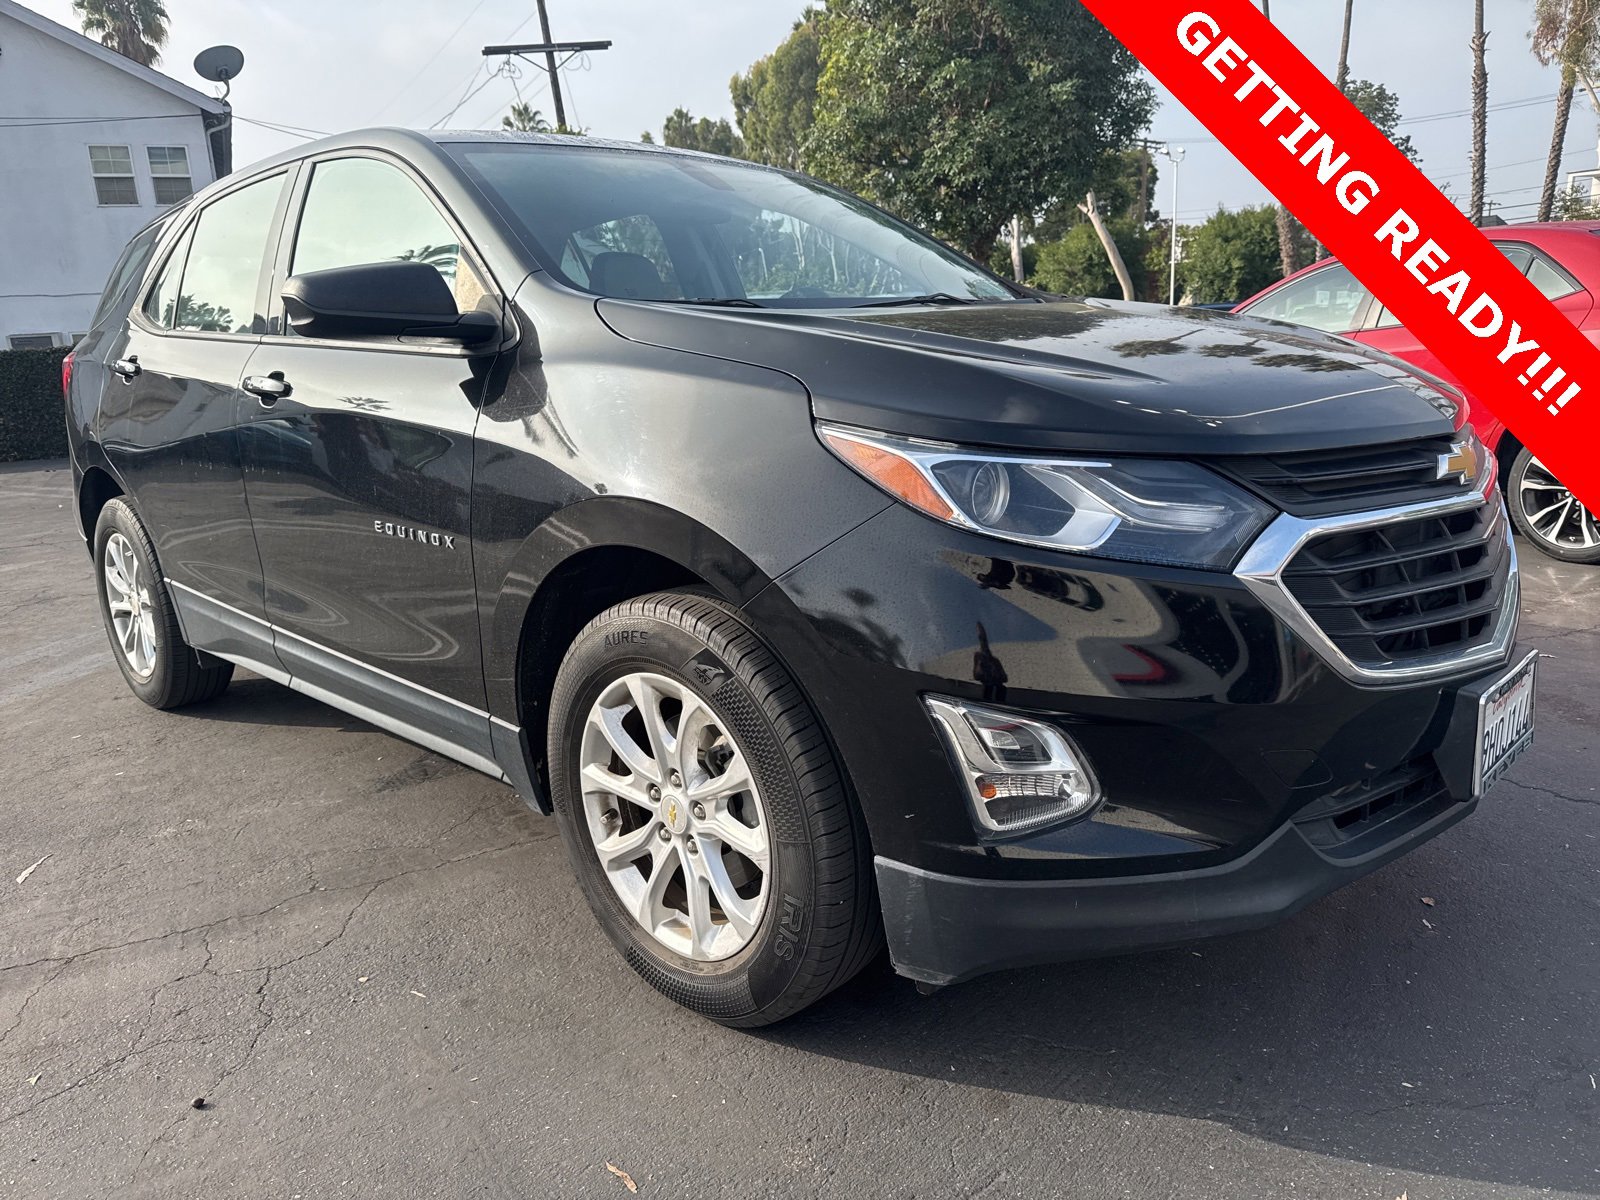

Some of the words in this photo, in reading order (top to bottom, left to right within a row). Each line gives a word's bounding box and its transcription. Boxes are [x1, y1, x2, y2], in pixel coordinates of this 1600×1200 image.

[374, 520, 456, 550] EQUINOX
[604, 630, 649, 648] AURES
[773, 893, 804, 961] IRIS
